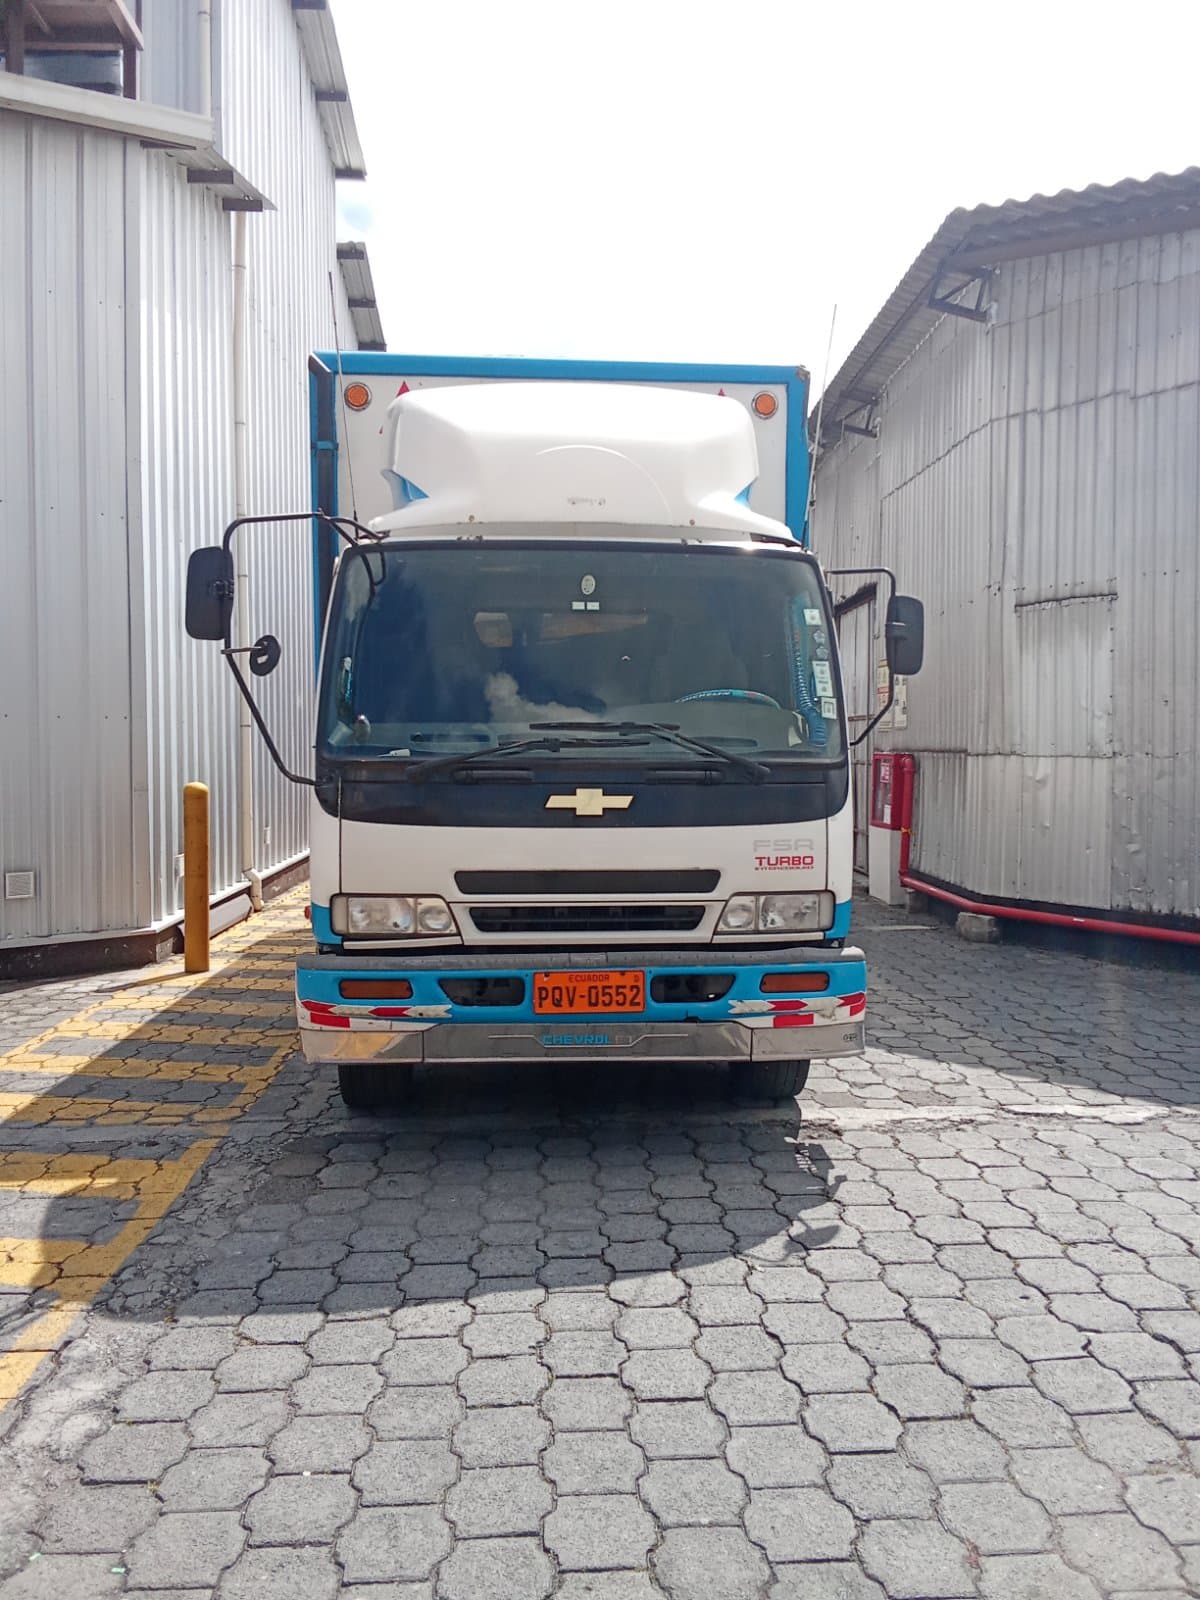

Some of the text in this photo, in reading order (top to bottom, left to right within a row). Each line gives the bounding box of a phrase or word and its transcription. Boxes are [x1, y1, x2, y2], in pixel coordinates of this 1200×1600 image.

[753, 839, 814, 851] FSR
[755, 855, 814, 866] TURBO
[568, 974, 610, 983] ECUADOR
[537, 985, 641, 1008] PQV-0552
